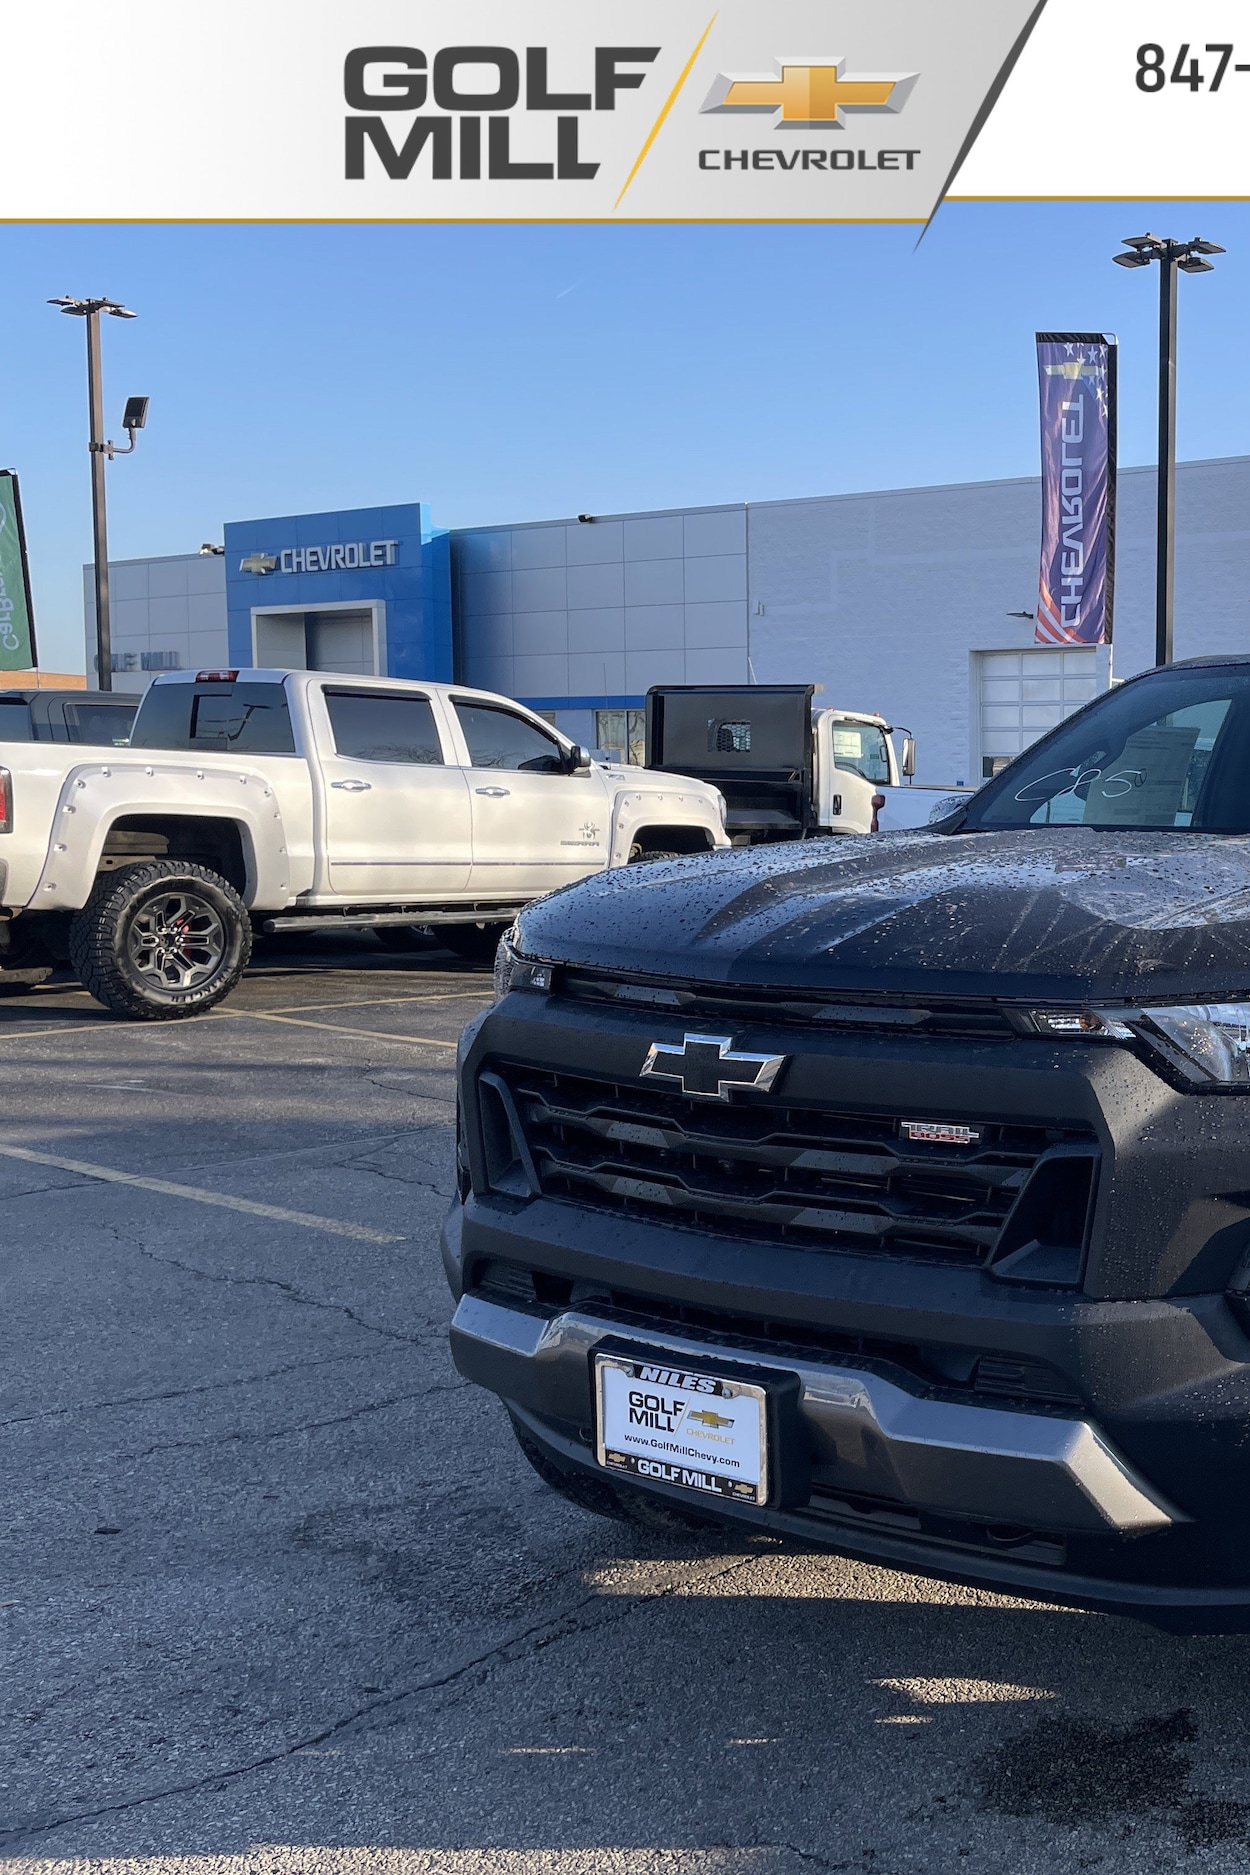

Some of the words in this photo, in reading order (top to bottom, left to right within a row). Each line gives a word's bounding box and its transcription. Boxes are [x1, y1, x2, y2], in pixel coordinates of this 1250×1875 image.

[281, 540, 399, 573] CHEVROLET
[901, 1121, 980, 1139] TRAIL
[909, 1131, 971, 1144] BOSS
[639, 1366, 717, 1394] NILES
[628, 1390, 685, 1416] GOLF
[629, 1408, 675, 1433] MILL
[686, 1428, 736, 1445] CHEVROLET
[624, 1433, 740, 1468] www.GolfMillChevy.com
[637, 1459, 681, 1482] GOLF
[682, 1471, 722, 1493] MILL
